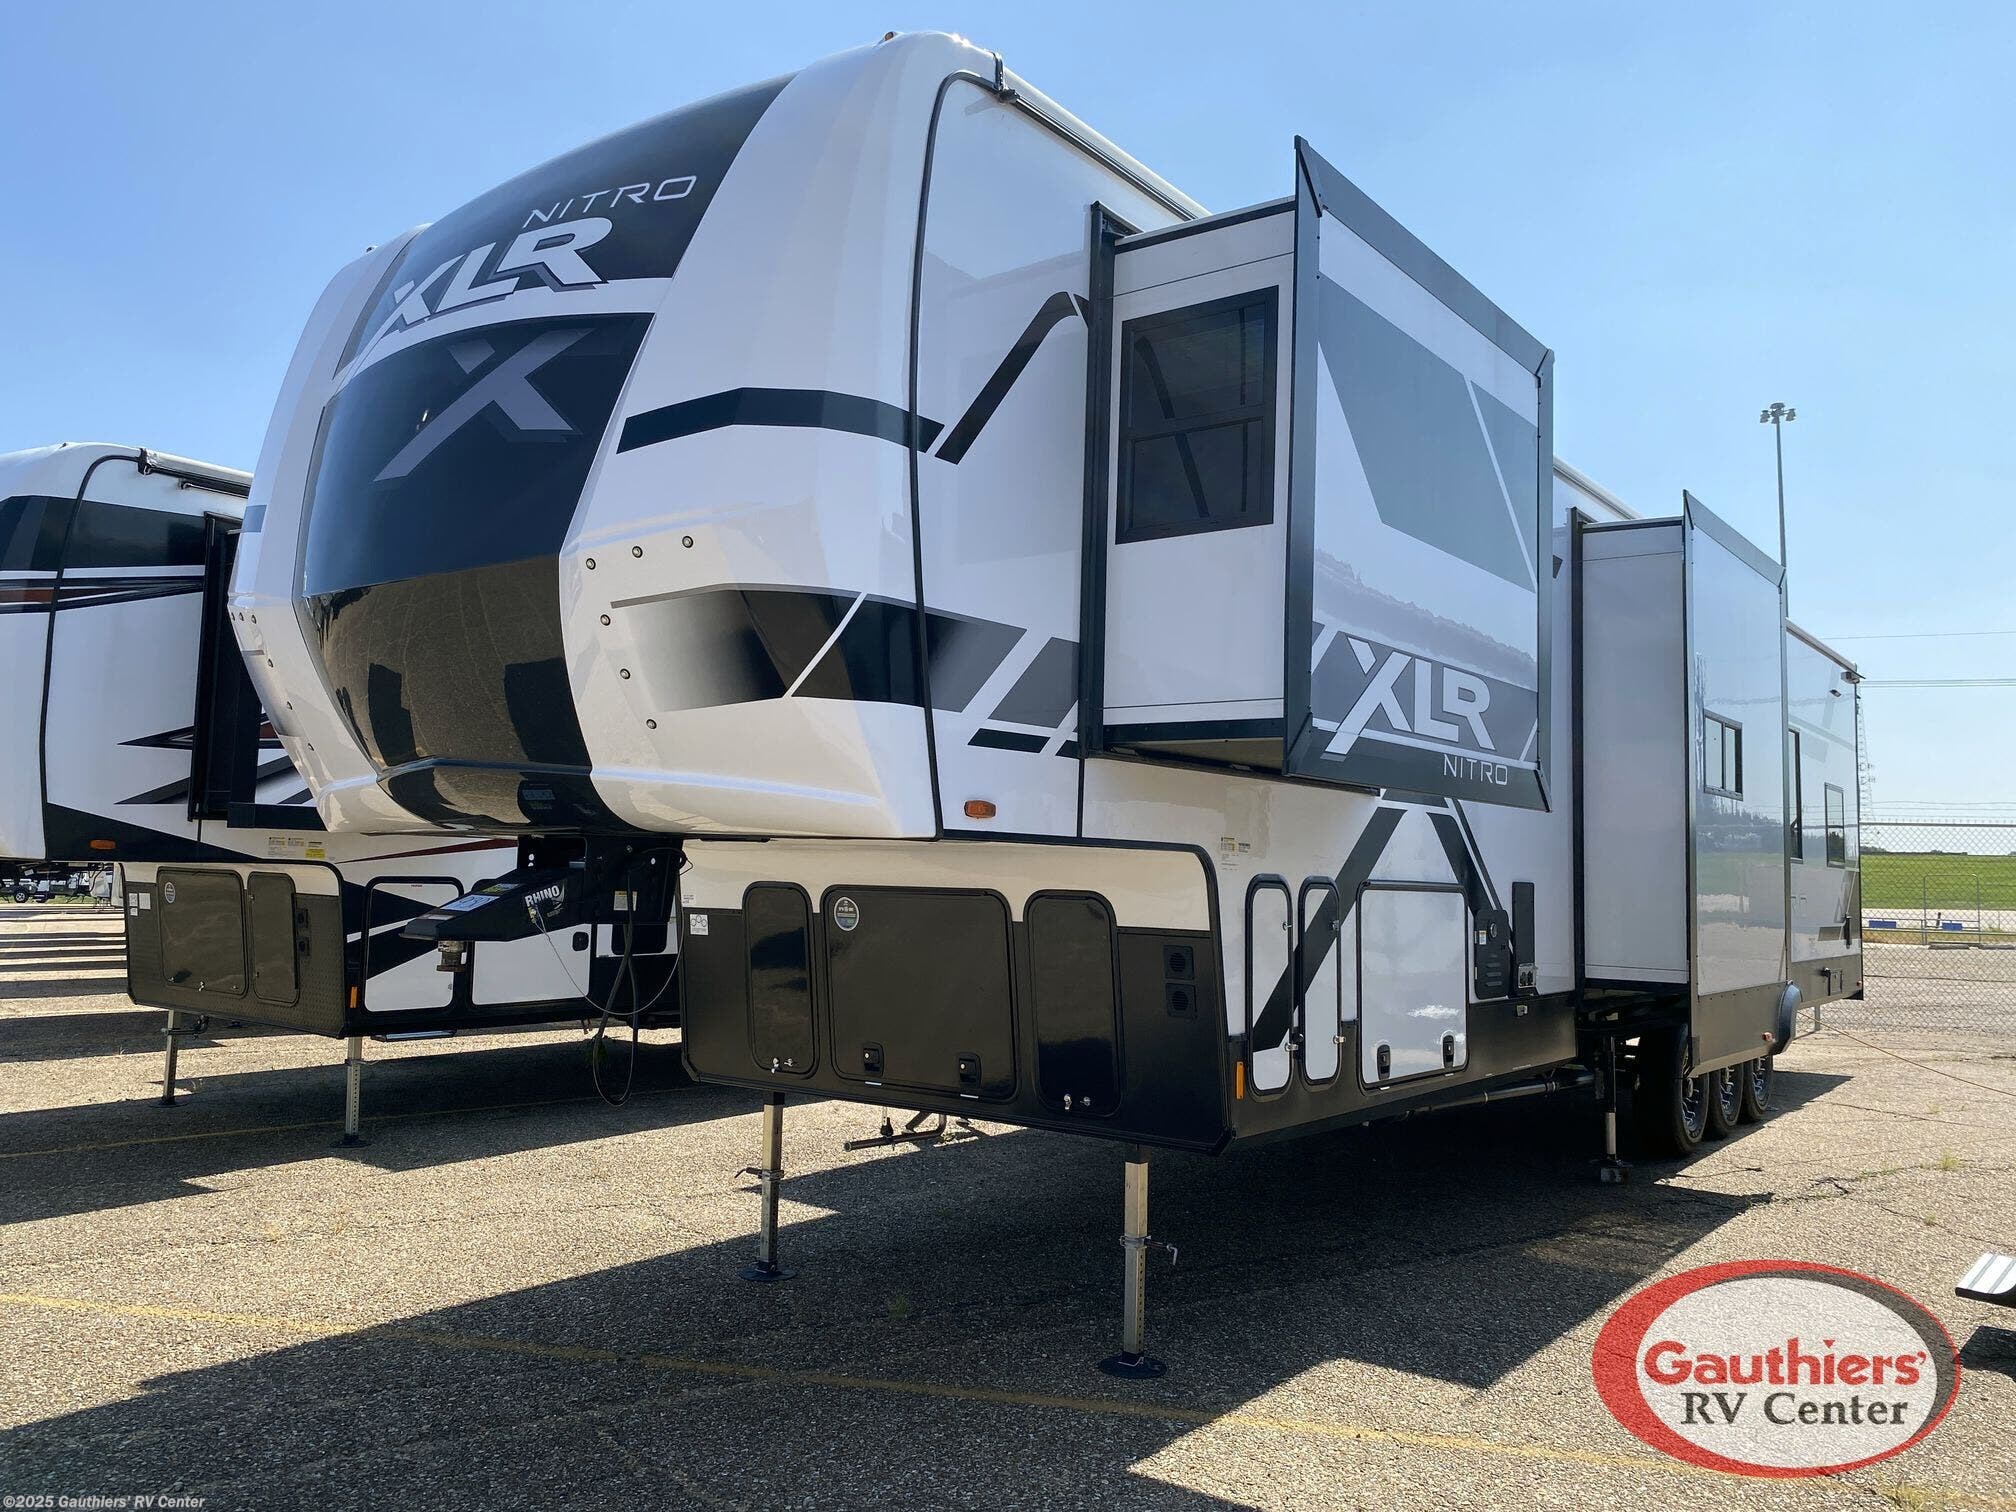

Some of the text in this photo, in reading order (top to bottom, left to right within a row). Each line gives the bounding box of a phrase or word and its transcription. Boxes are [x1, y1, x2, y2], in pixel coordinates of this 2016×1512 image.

[522, 175, 697, 228] NITRO
[376, 217, 612, 335] XLR
[1325, 637, 1495, 757] XLR
[1443, 753, 1508, 786] NITRO
[525, 885, 560, 907] RHINO
